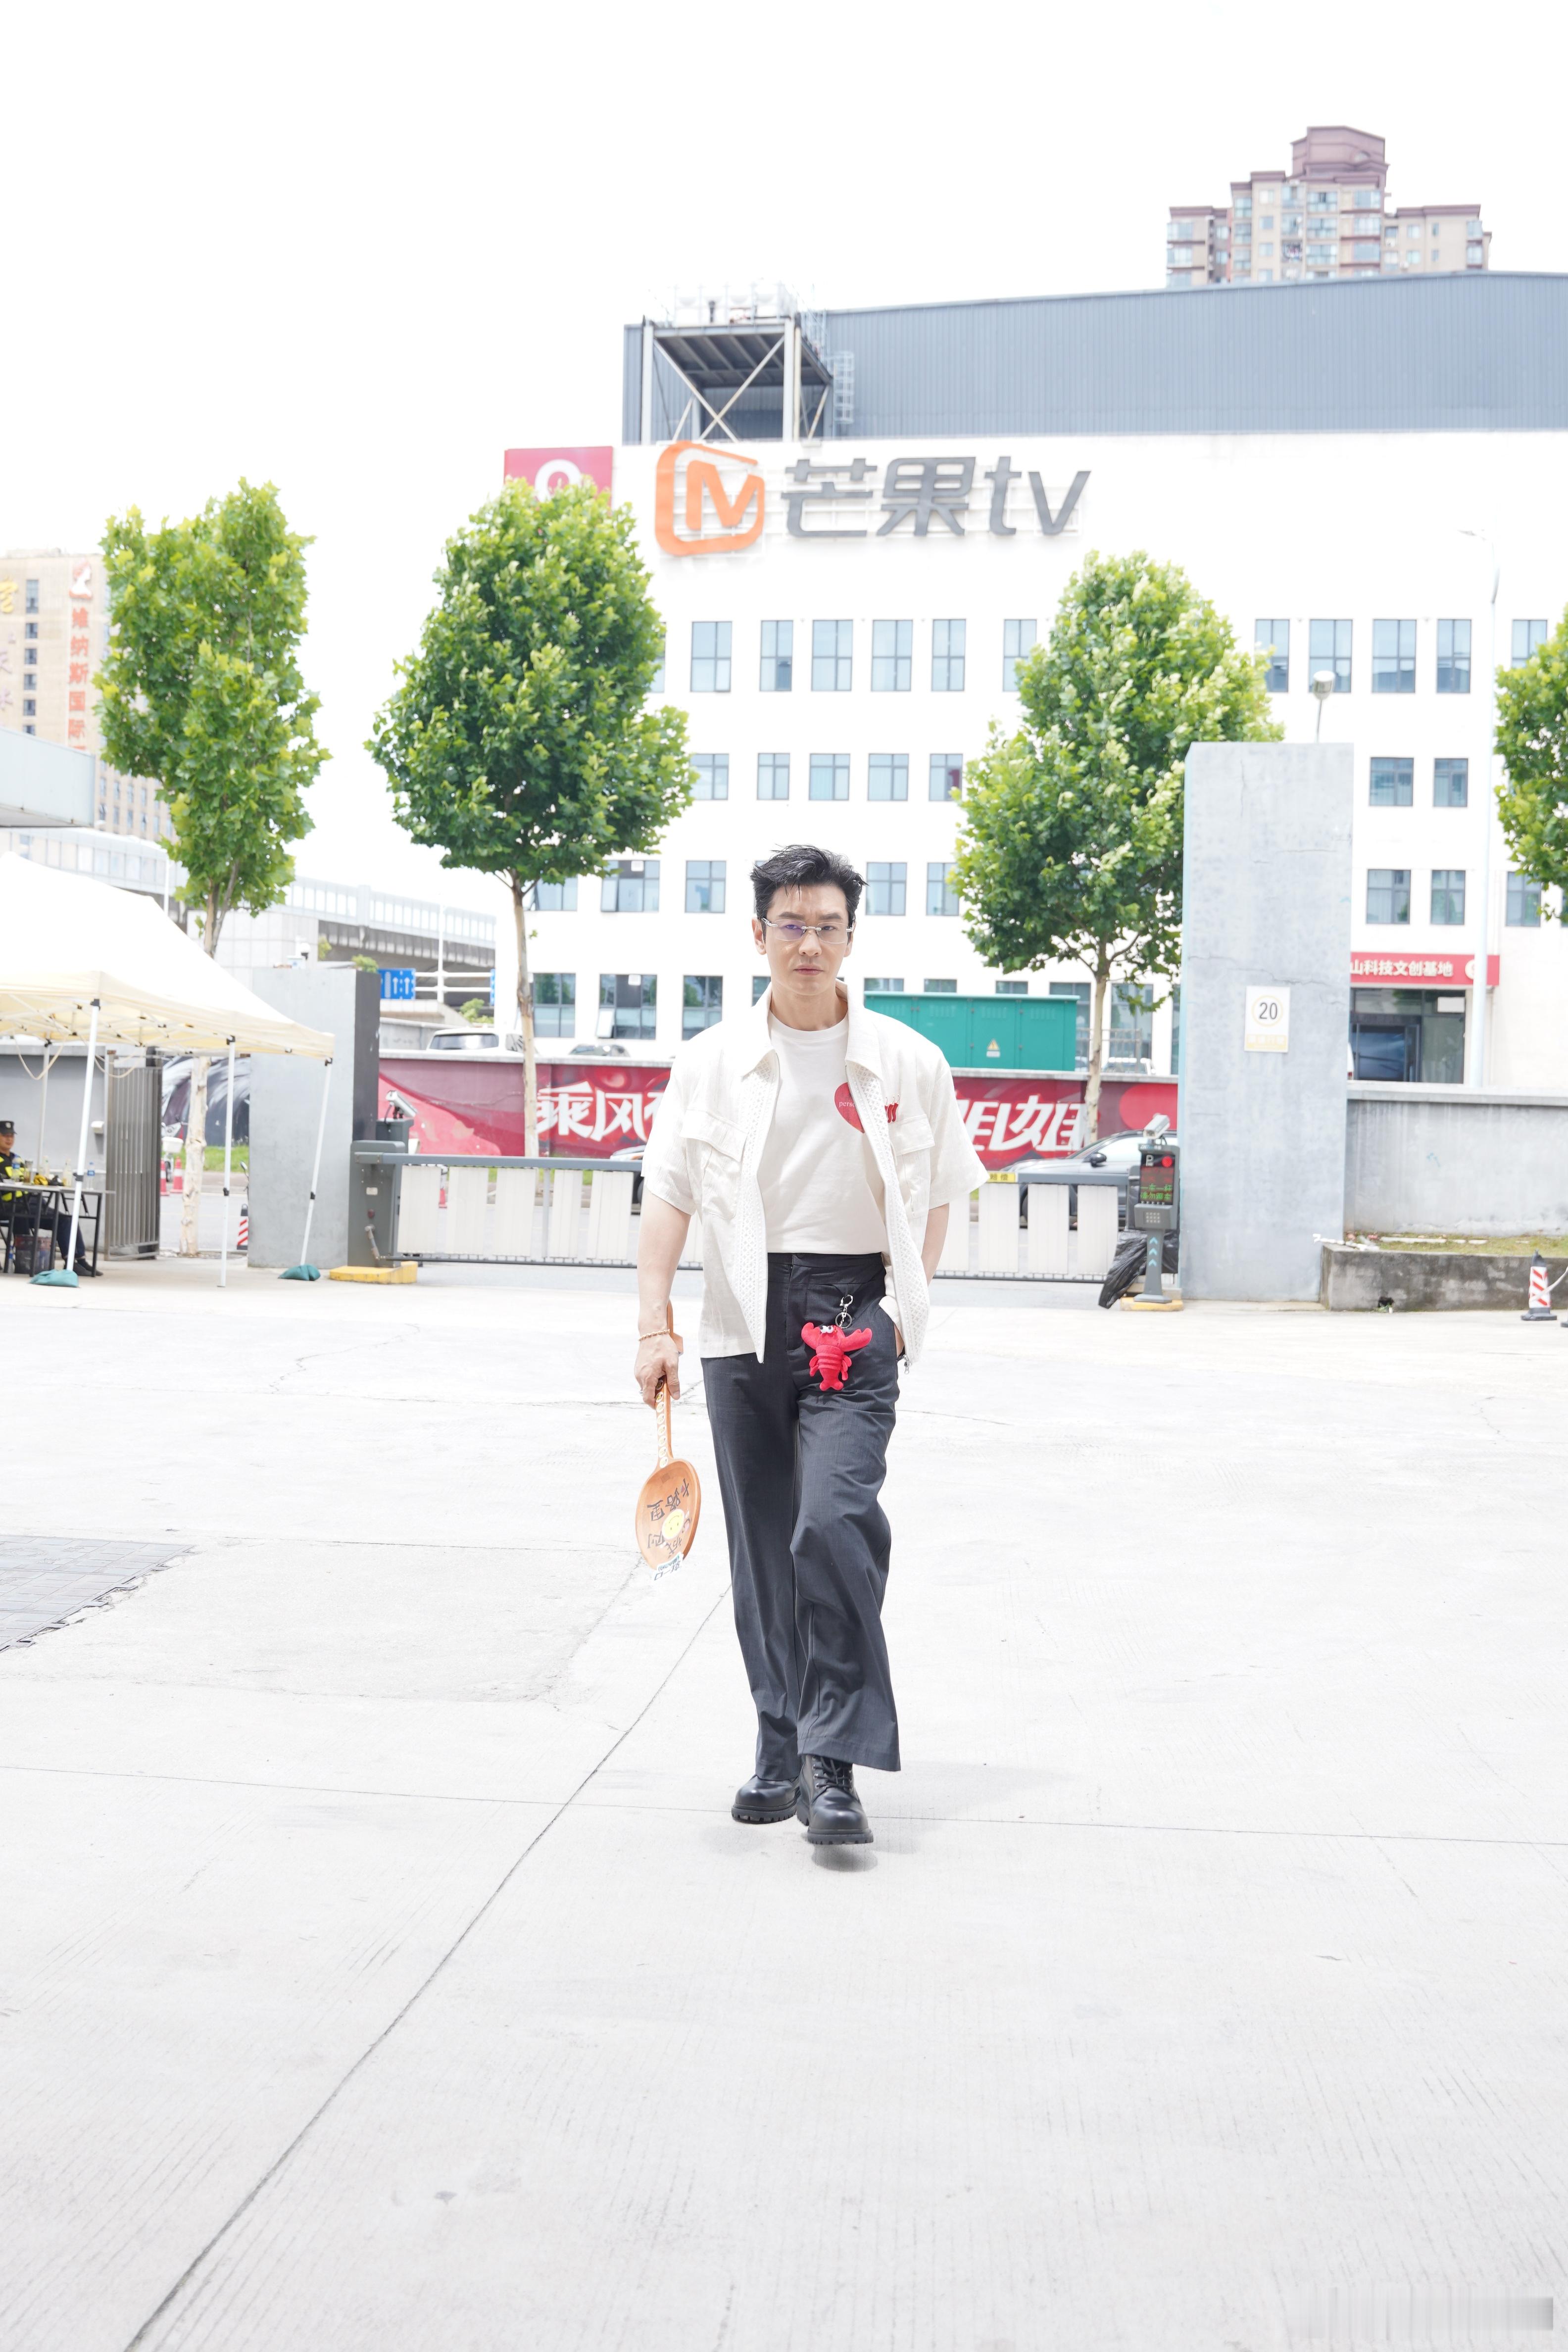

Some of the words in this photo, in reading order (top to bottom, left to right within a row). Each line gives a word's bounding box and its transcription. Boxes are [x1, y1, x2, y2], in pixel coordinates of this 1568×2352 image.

[781, 456, 1091, 536] 芒果tv
[67, 607, 89, 751] 维纳斯国际
[1350, 958, 1454, 978] 山科技文创基地
[1259, 1002, 1278, 1020] 20
[536, 1080, 664, 1142] 乘风
[1146, 1155, 1154, 1167] P
